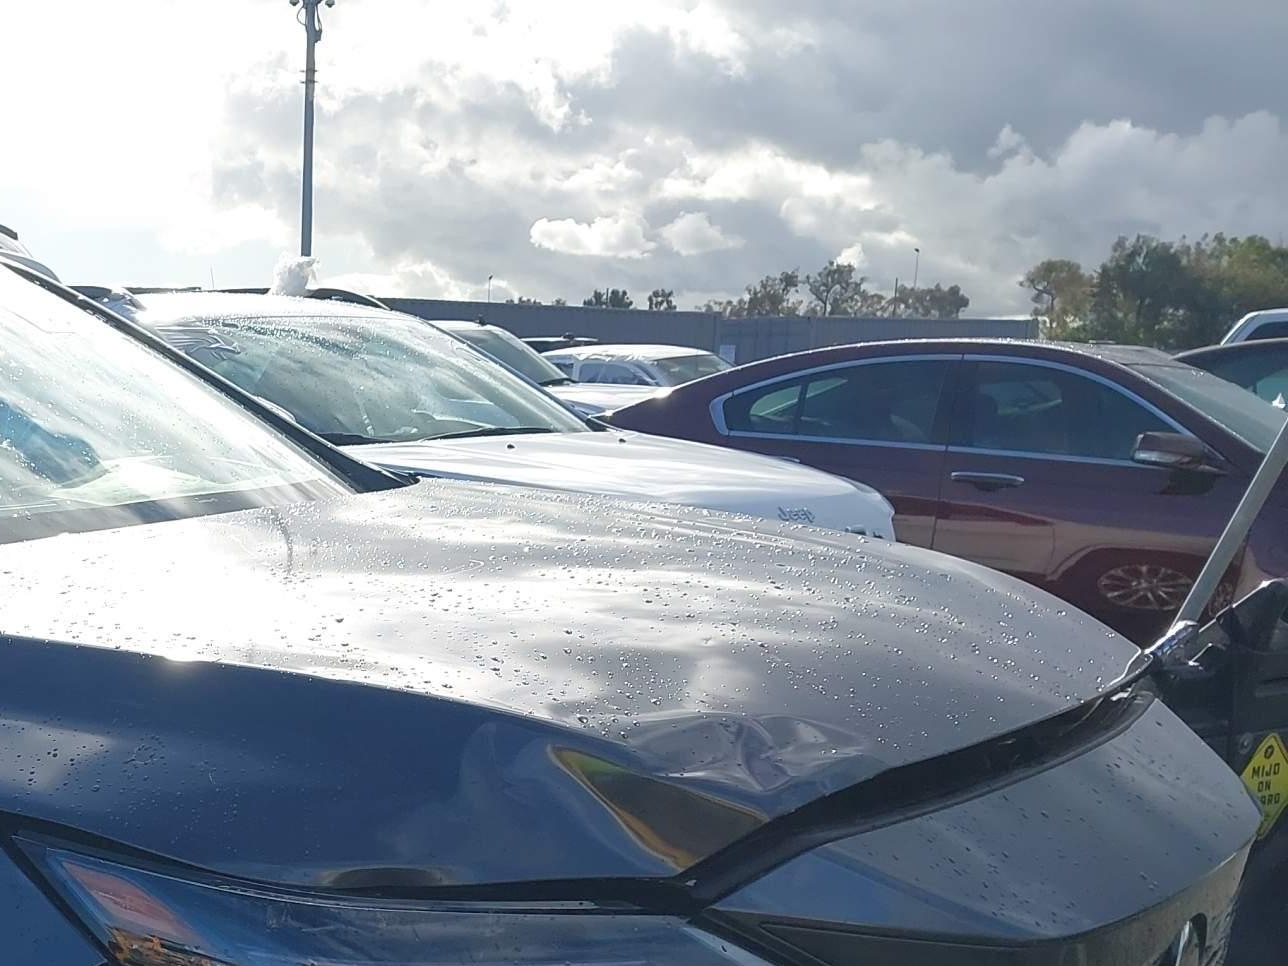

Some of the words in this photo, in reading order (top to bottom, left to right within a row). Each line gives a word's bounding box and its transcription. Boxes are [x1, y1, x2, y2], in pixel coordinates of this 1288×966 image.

[777, 505, 815, 523] Jeep
[1251, 762, 1281, 779] MIJO
[1257, 780, 1272, 793] ON
